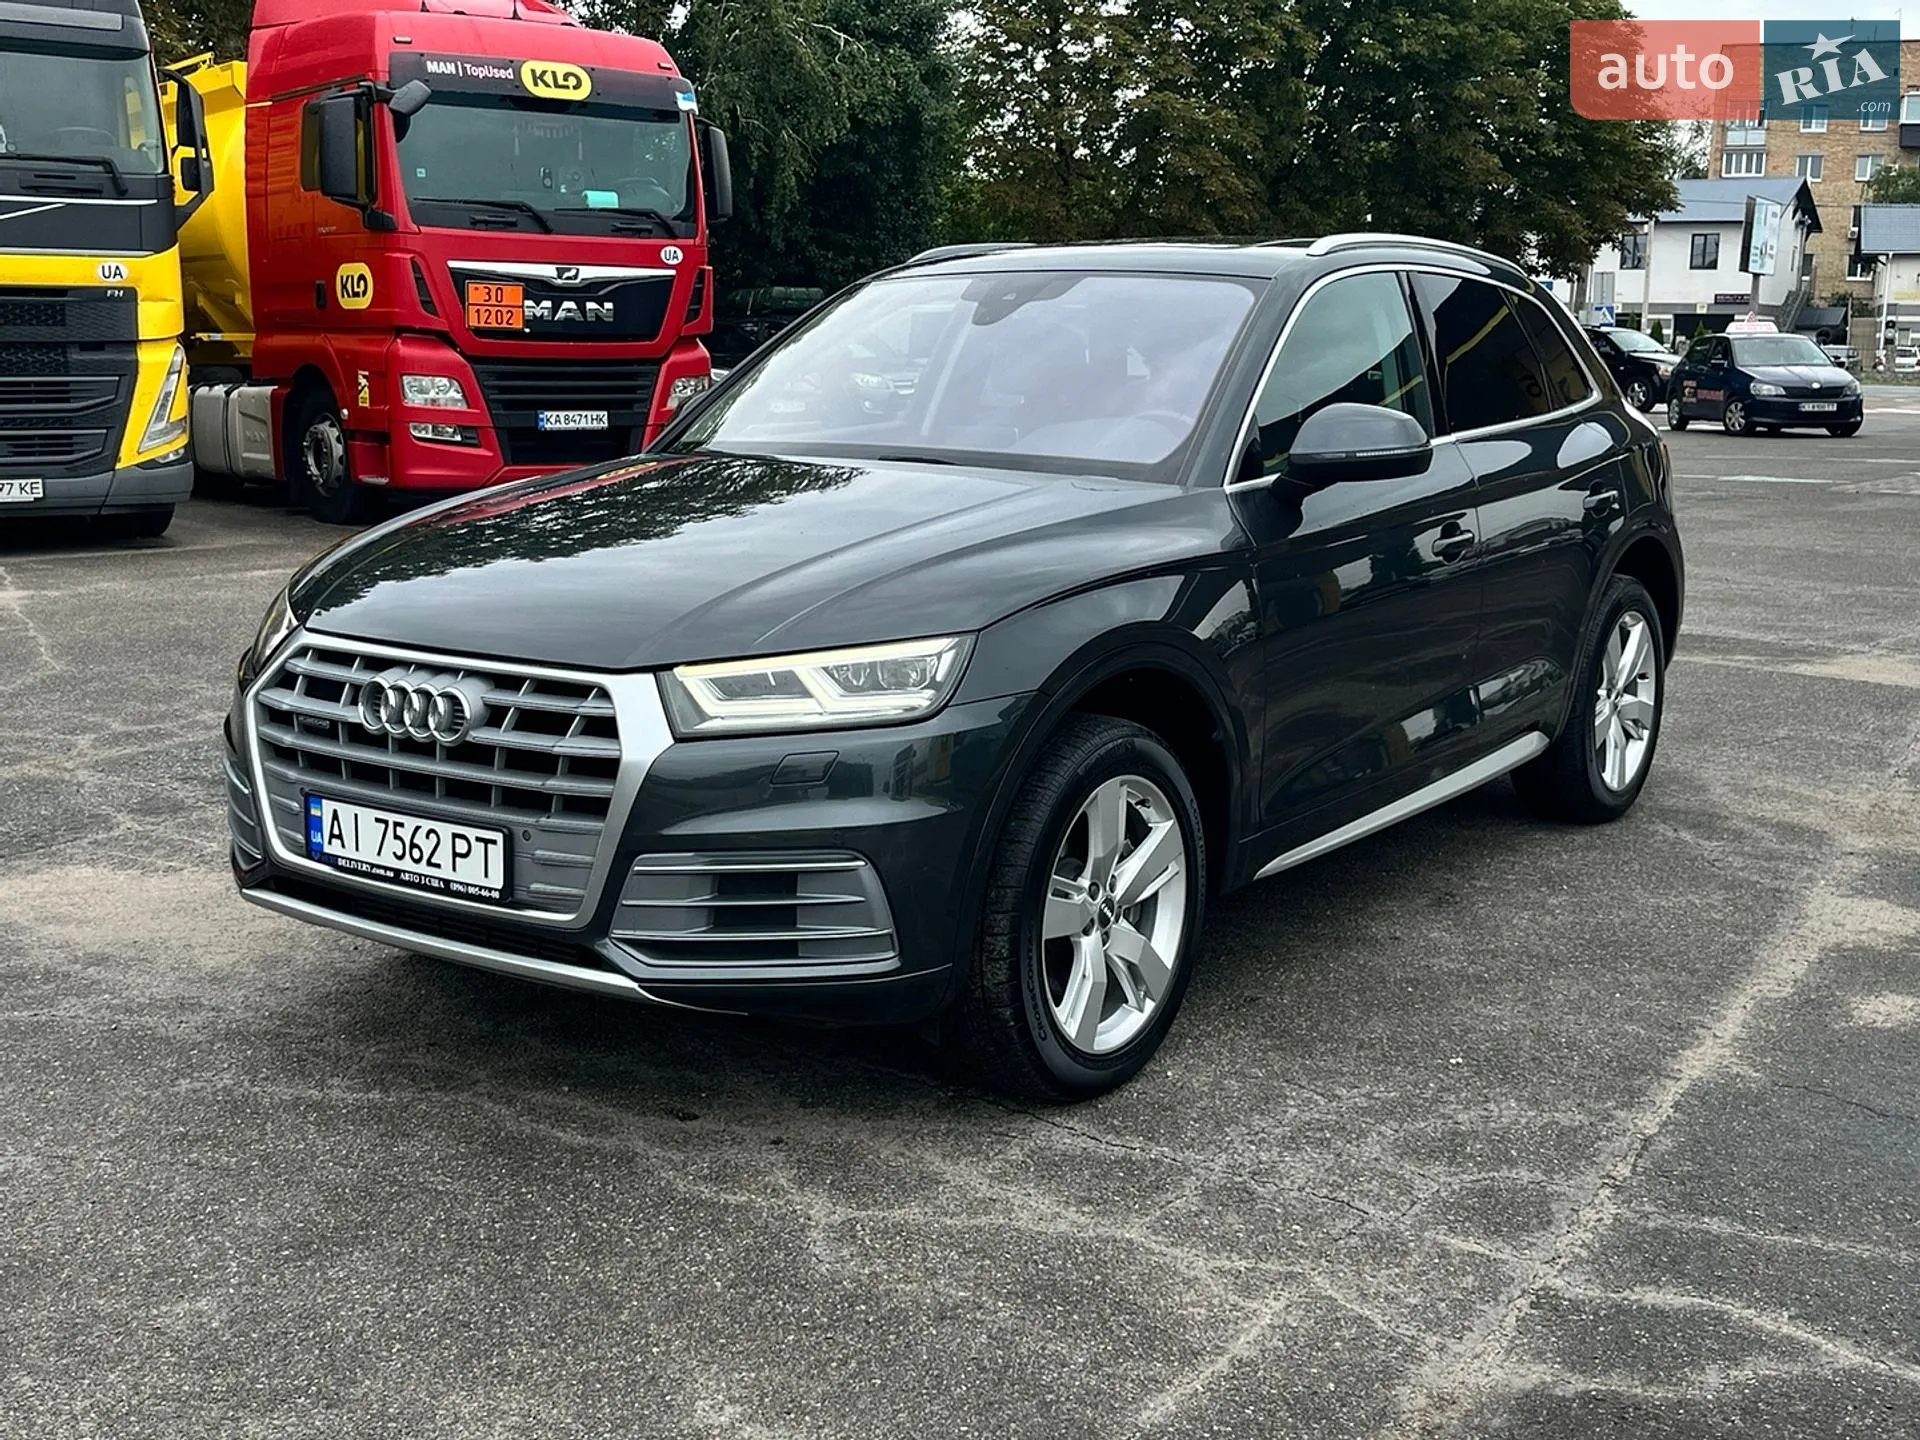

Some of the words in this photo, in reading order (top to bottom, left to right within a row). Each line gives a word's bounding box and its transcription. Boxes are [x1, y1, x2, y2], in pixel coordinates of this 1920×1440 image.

[426, 60, 456, 75] MAN
[464, 63, 514, 80] TopUsed
[530, 68, 583, 91] KLO
[664, 249, 680, 262] UA
[101, 264, 124, 279] UA
[340, 273, 369, 299] KLO
[483, 286, 504, 304] 30
[474, 308, 514, 326] 1202
[524, 300, 614, 323] MAN
[19, 481, 41, 496] KE
[310, 830, 323, 844] UA
[327, 808, 360, 852] AI
[374, 816, 442, 869] 7562
[451, 831, 498, 879] PT
